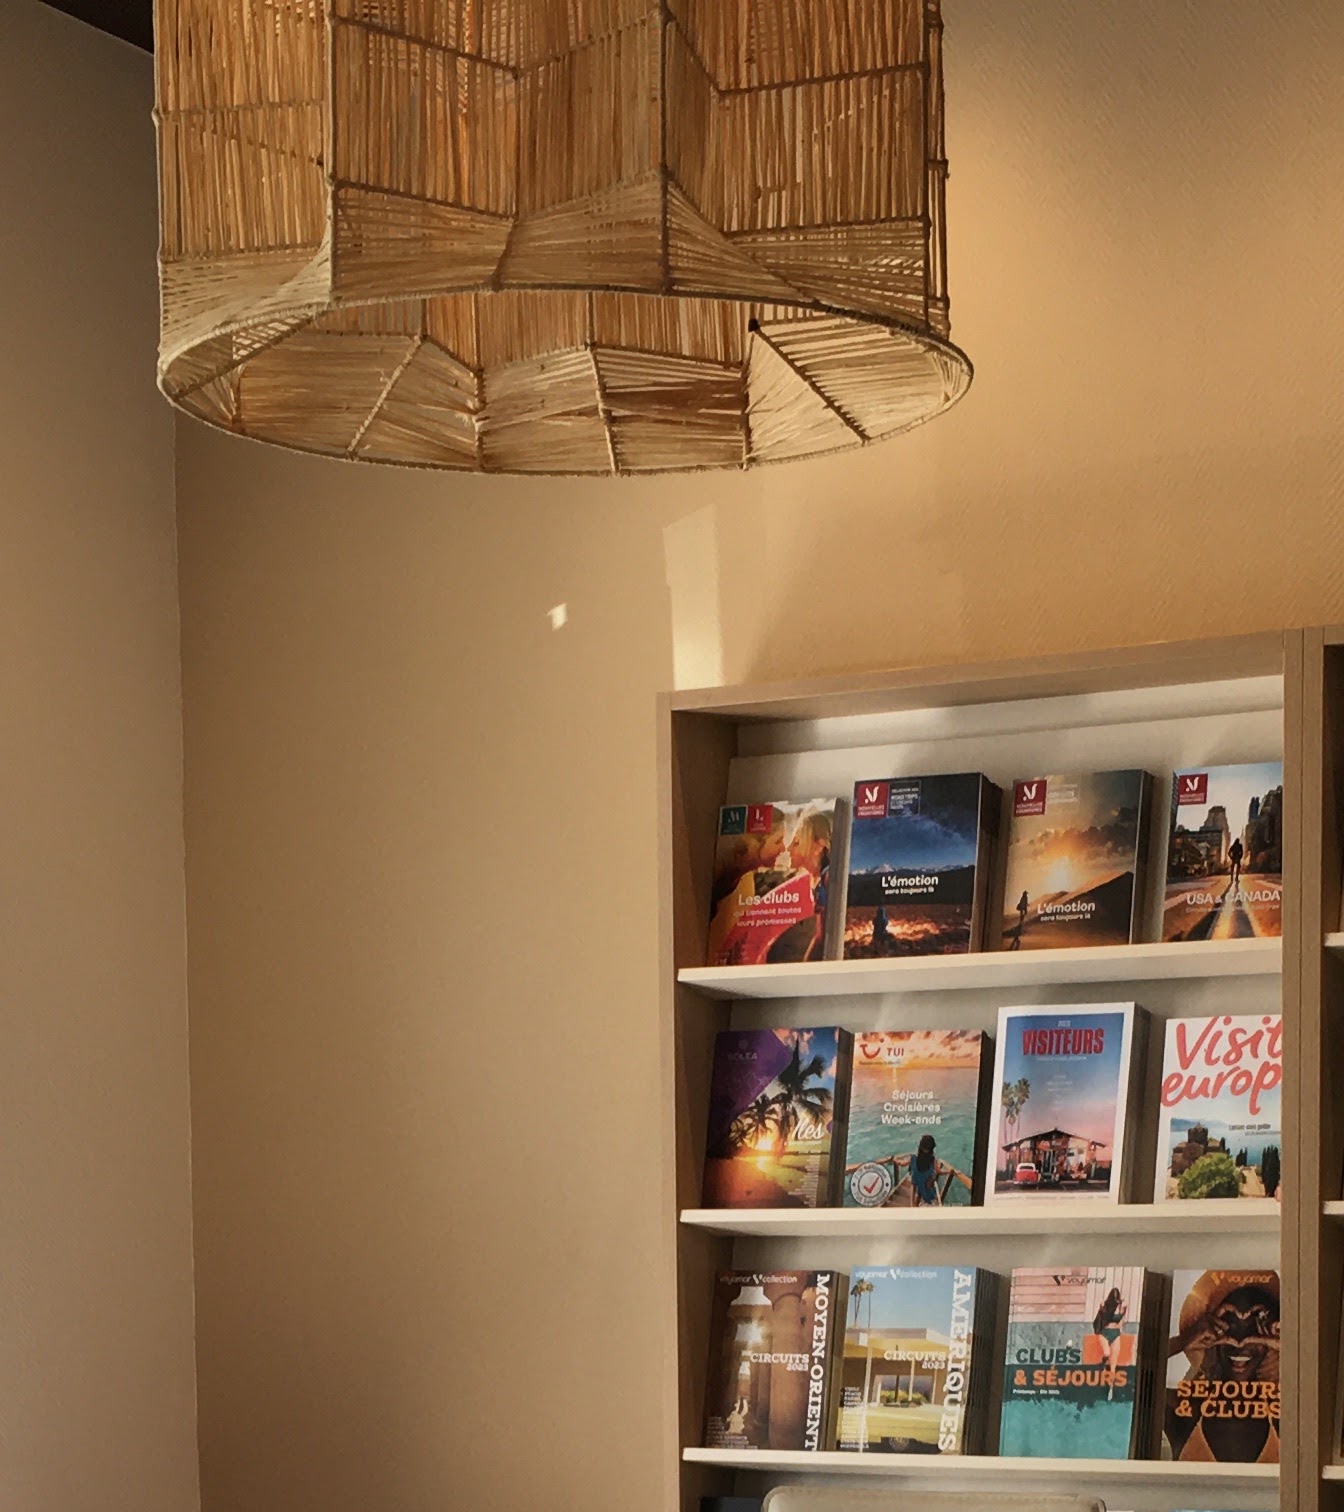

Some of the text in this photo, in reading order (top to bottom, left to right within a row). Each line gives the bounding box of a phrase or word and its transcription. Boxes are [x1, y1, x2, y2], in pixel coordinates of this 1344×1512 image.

[881, 875, 939, 888] L'émotion
[739, 891, 799, 906] Les clubs
[1187, 893, 1214, 905] USA
[1225, 890, 1281, 904] CANADA
[1037, 900, 1096, 915] L'émotion
[1022, 1028, 1105, 1056] VISITEURS
[887, 1047, 905, 1057] TUI
[1162, 1060, 1282, 1115] europ
[892, 1089, 934, 1102] Séjours
[883, 1101, 941, 1113] Croisières
[881, 1114, 942, 1126] Week-ends
[761, 1275, 797, 1284] collection
[1066, 1275, 1106, 1286] voyamar
[1227, 1274, 1274, 1285] voyamar
[750, 1352, 809, 1364] CIRCUITS
[883, 1351, 946, 1362] CIRCUITS
[938, 1269, 971, 1450] AMERIQUES
[1016, 1347, 1080, 1364] CLUBS
[805, 1274, 830, 1452] MOYEN-ORIENT
[1014, 1365, 1127, 1386] & SÉJOURS
[1175, 1400, 1280, 1418] & CLUBS
